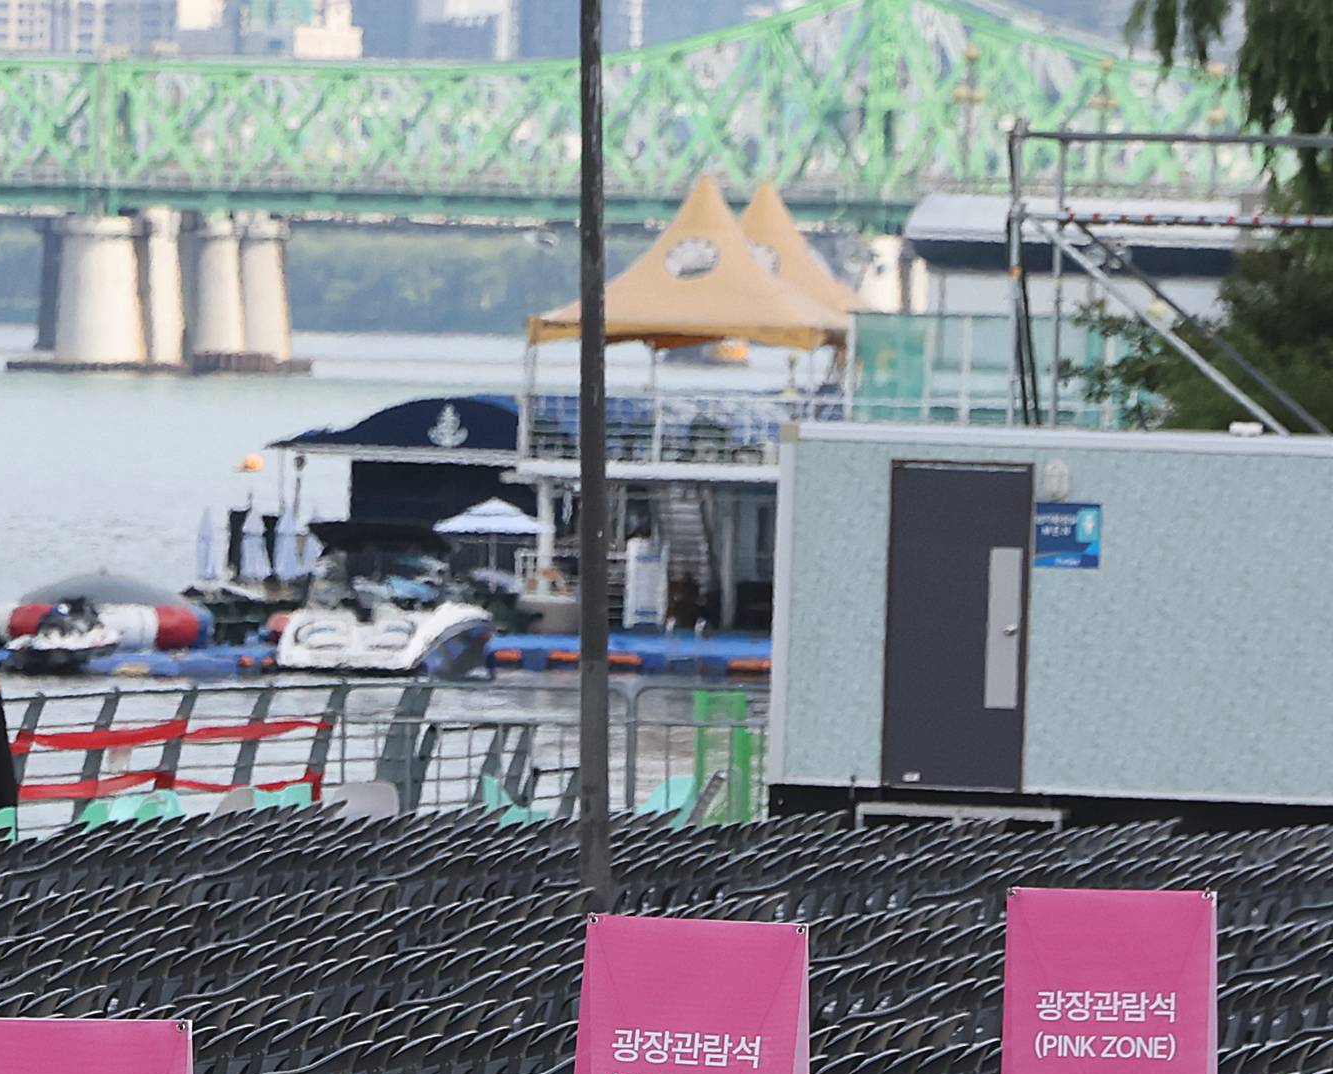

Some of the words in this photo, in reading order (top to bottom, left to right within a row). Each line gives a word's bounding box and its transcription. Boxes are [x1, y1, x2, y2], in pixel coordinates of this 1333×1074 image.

[1036, 990, 1177, 1023] 광장관람석
[611, 1029, 761, 1069] 광장관람석
[1035, 1031, 1097, 1059] (PINK
[1101, 1033, 1176, 1061] ZONE)
